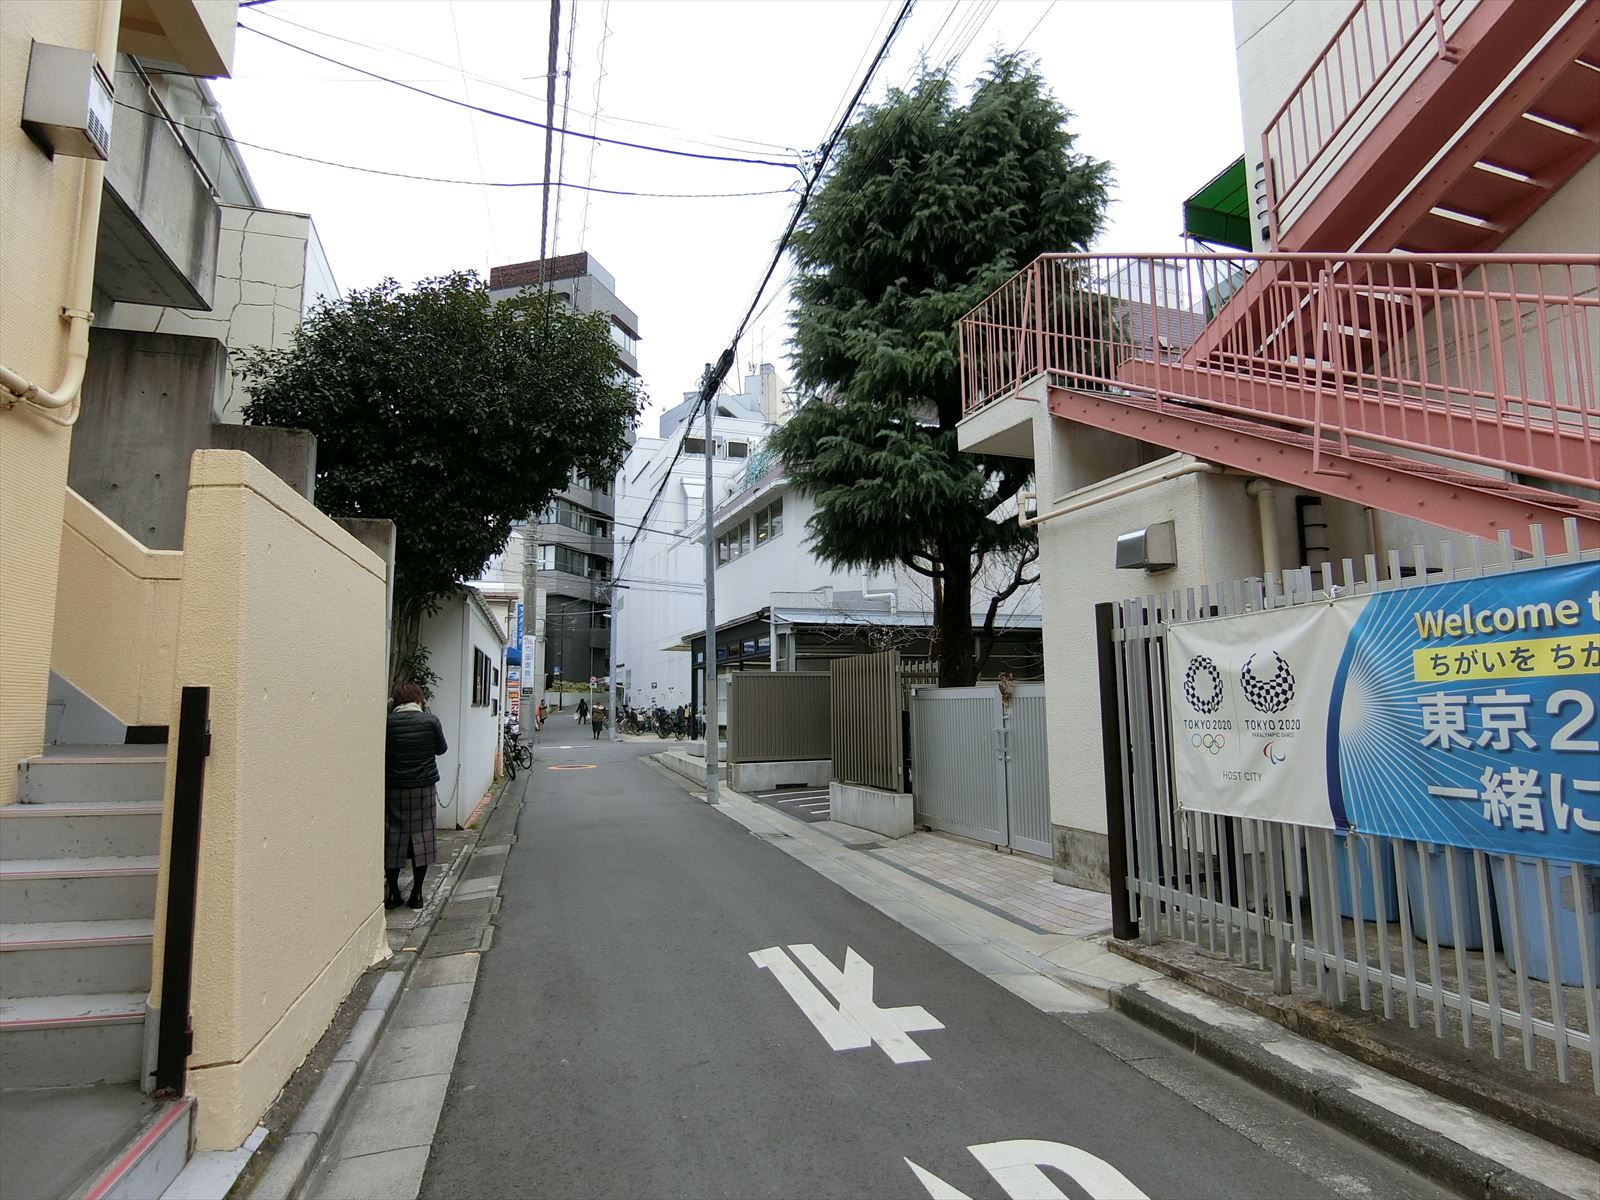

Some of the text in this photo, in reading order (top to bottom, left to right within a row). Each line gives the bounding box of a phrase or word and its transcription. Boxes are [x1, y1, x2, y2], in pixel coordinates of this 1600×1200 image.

[1414, 599, 1580, 640] Welcome
[1430, 646, 1535, 676] ちがいを
[1184, 719, 1232, 730] TOKYO 2020
[1245, 719, 1301, 731] TOKYO 2020
[1417, 689, 1600, 751] 東京2
[1223, 770, 1263, 782] HOST CITY
[1427, 766, 1600, 832] 一緒に
